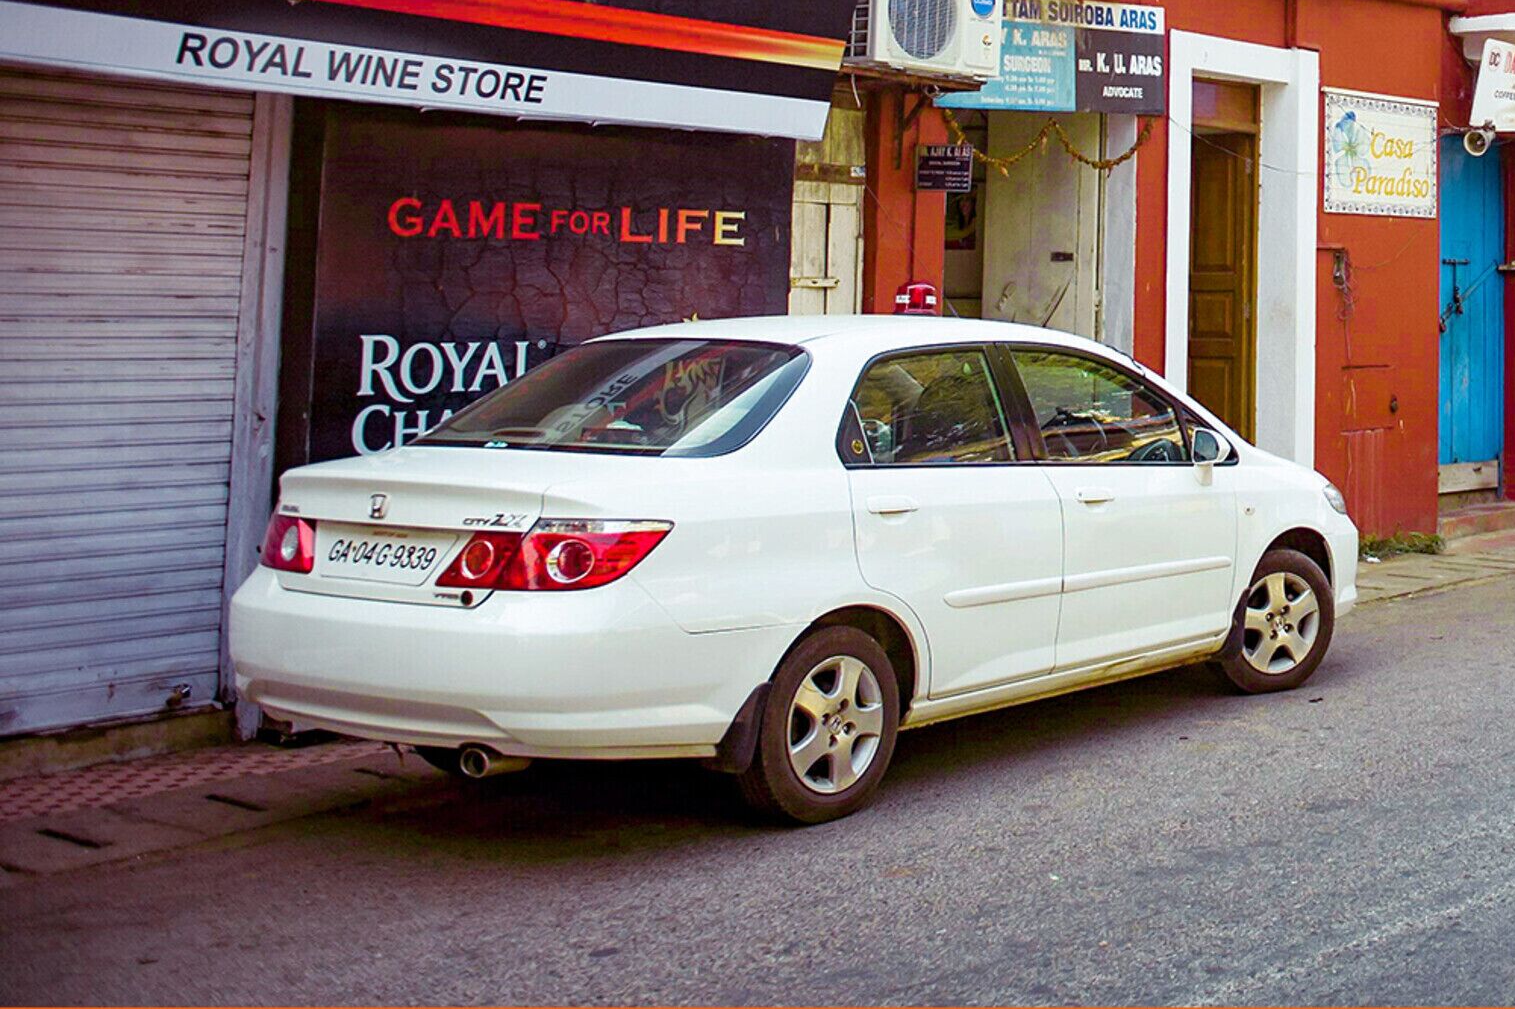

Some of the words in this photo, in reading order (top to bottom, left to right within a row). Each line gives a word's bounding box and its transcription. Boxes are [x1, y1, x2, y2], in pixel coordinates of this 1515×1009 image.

[1120, 8, 1157, 30] ARAS
[176, 32, 312, 79] ROYAL
[327, 50, 423, 91] WINE
[431, 63, 548, 104] STORE
[1129, 55, 1162, 76] ARAS
[1102, 86, 1144, 99] ADVOCATE
[1370, 131, 1413, 159] Casa
[1350, 166, 1430, 198] Paradiso
[388, 197, 542, 240] GAME
[551, 210, 611, 236] FOR
[620, 206, 746, 246] LIFE
